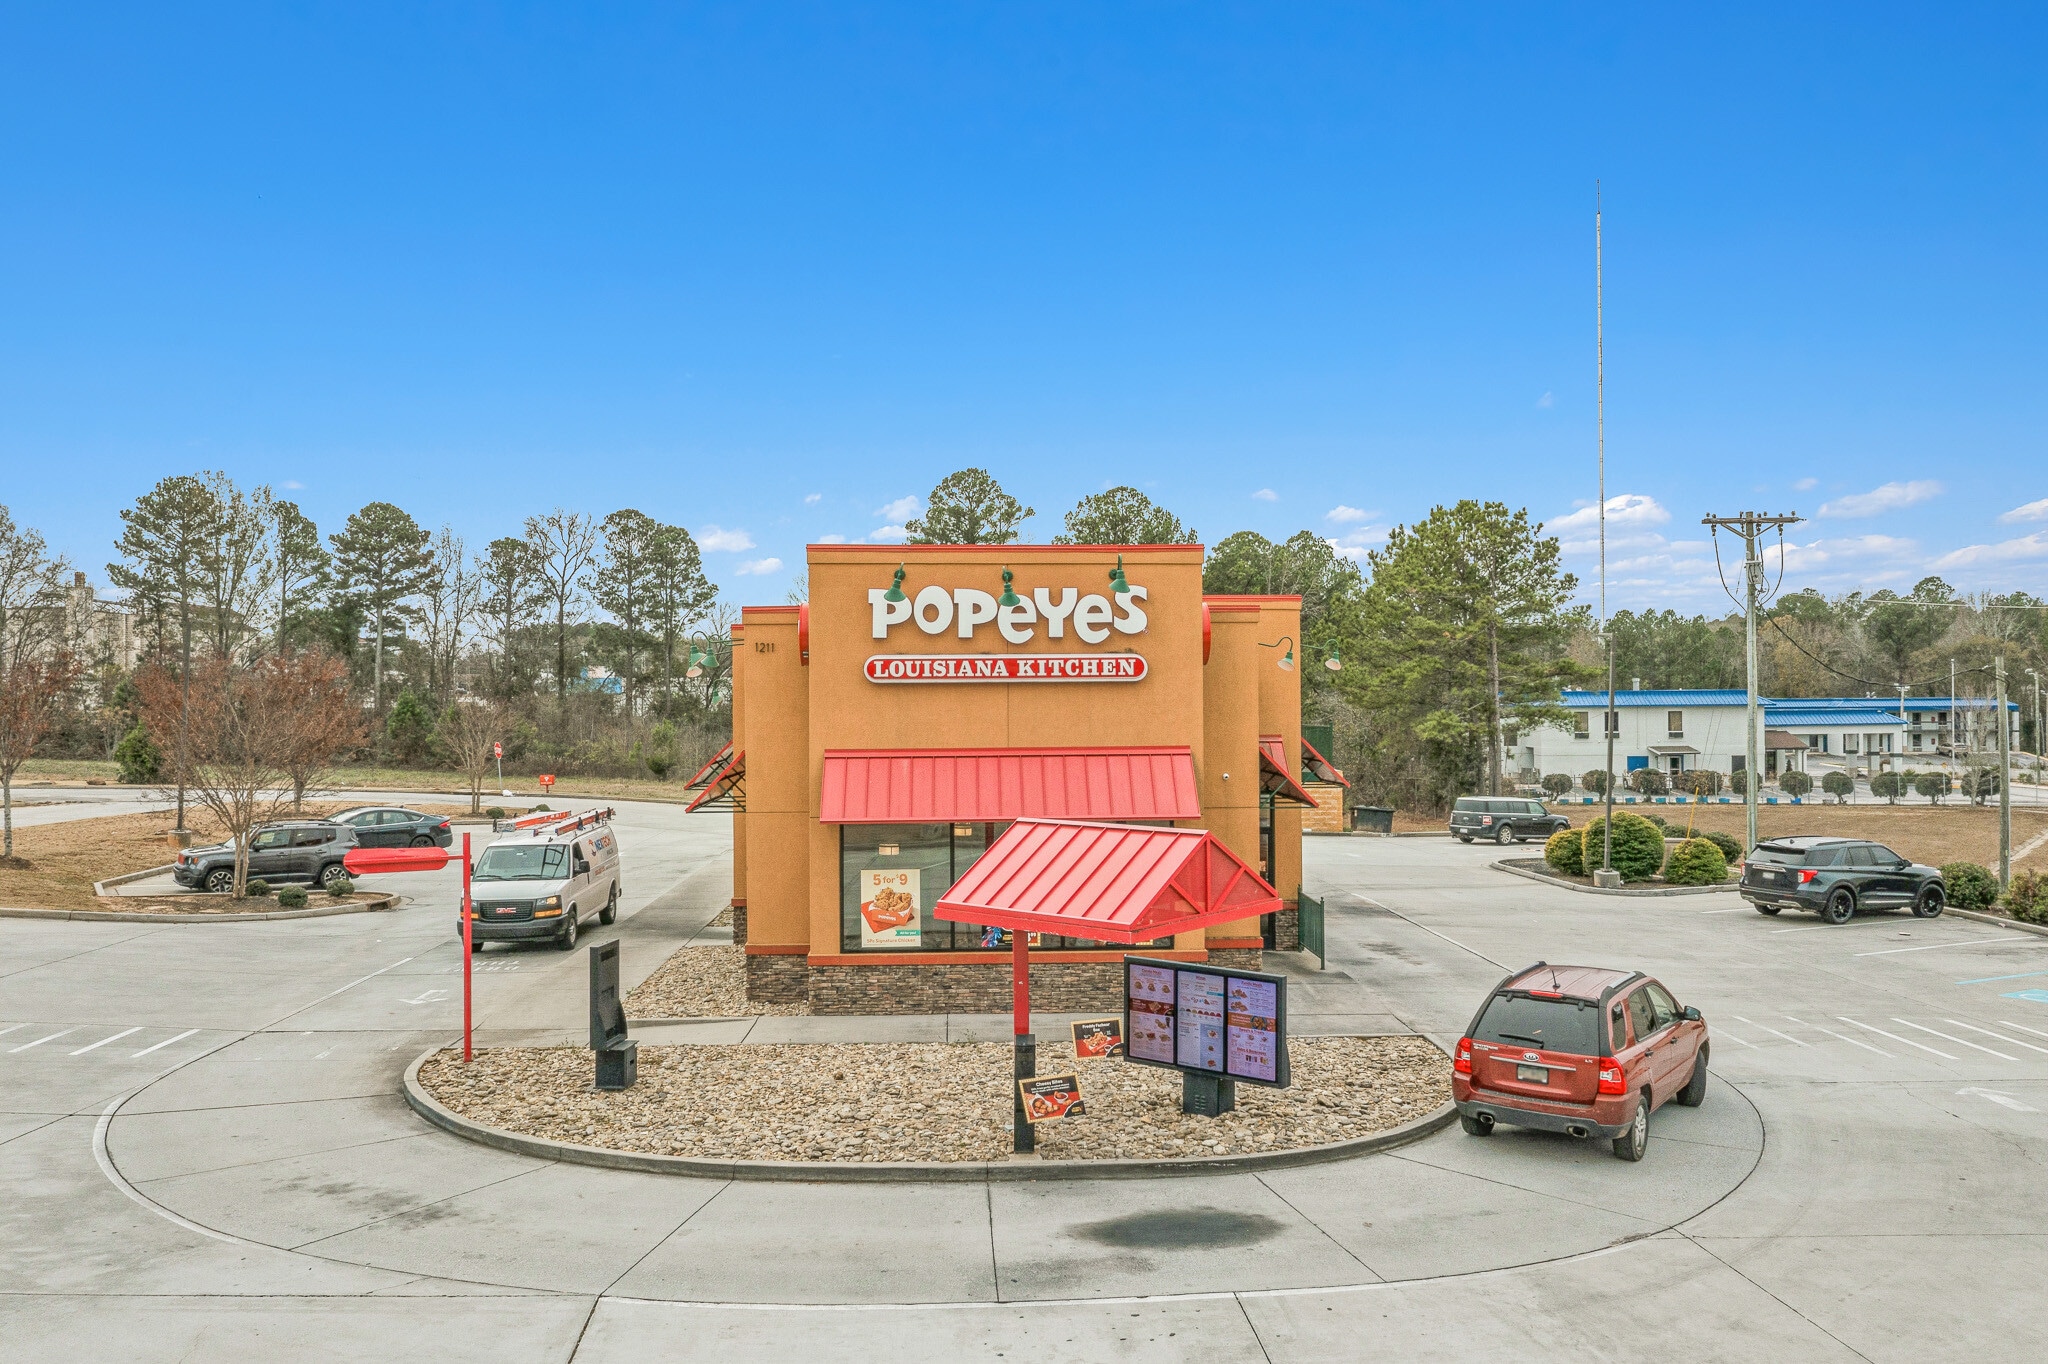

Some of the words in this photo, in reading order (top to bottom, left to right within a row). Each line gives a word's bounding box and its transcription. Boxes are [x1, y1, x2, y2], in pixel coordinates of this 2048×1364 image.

[755, 642, 775, 653] 1211
[873, 658, 1009, 678] LOUISIANA
[1017, 658, 1136, 677] KITCHEN
[873, 873, 882, 886] 5
[883, 875, 895, 884] for
